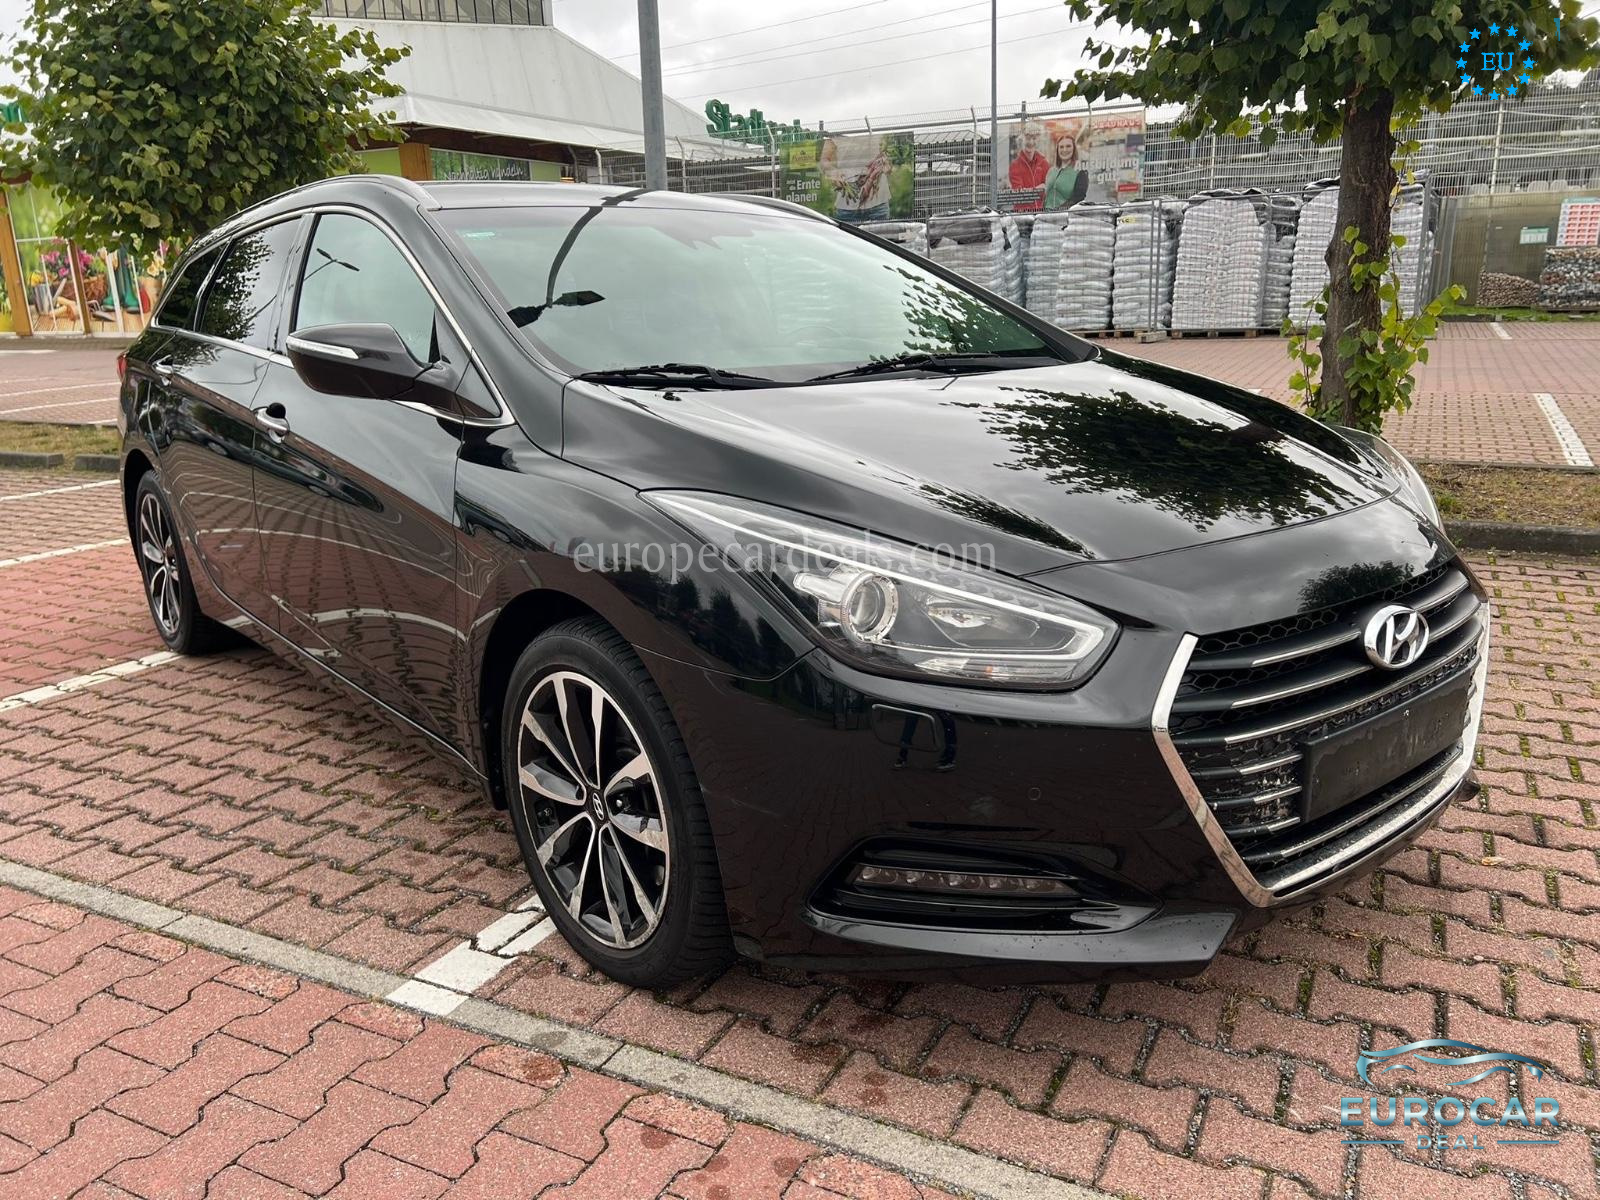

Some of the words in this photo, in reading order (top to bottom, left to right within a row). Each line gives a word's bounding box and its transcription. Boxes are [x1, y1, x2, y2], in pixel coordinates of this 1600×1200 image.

[1074, 157, 1139, 172] Ausbildung
[797, 179, 821, 191] Ernte
[786, 191, 817, 203] planen
